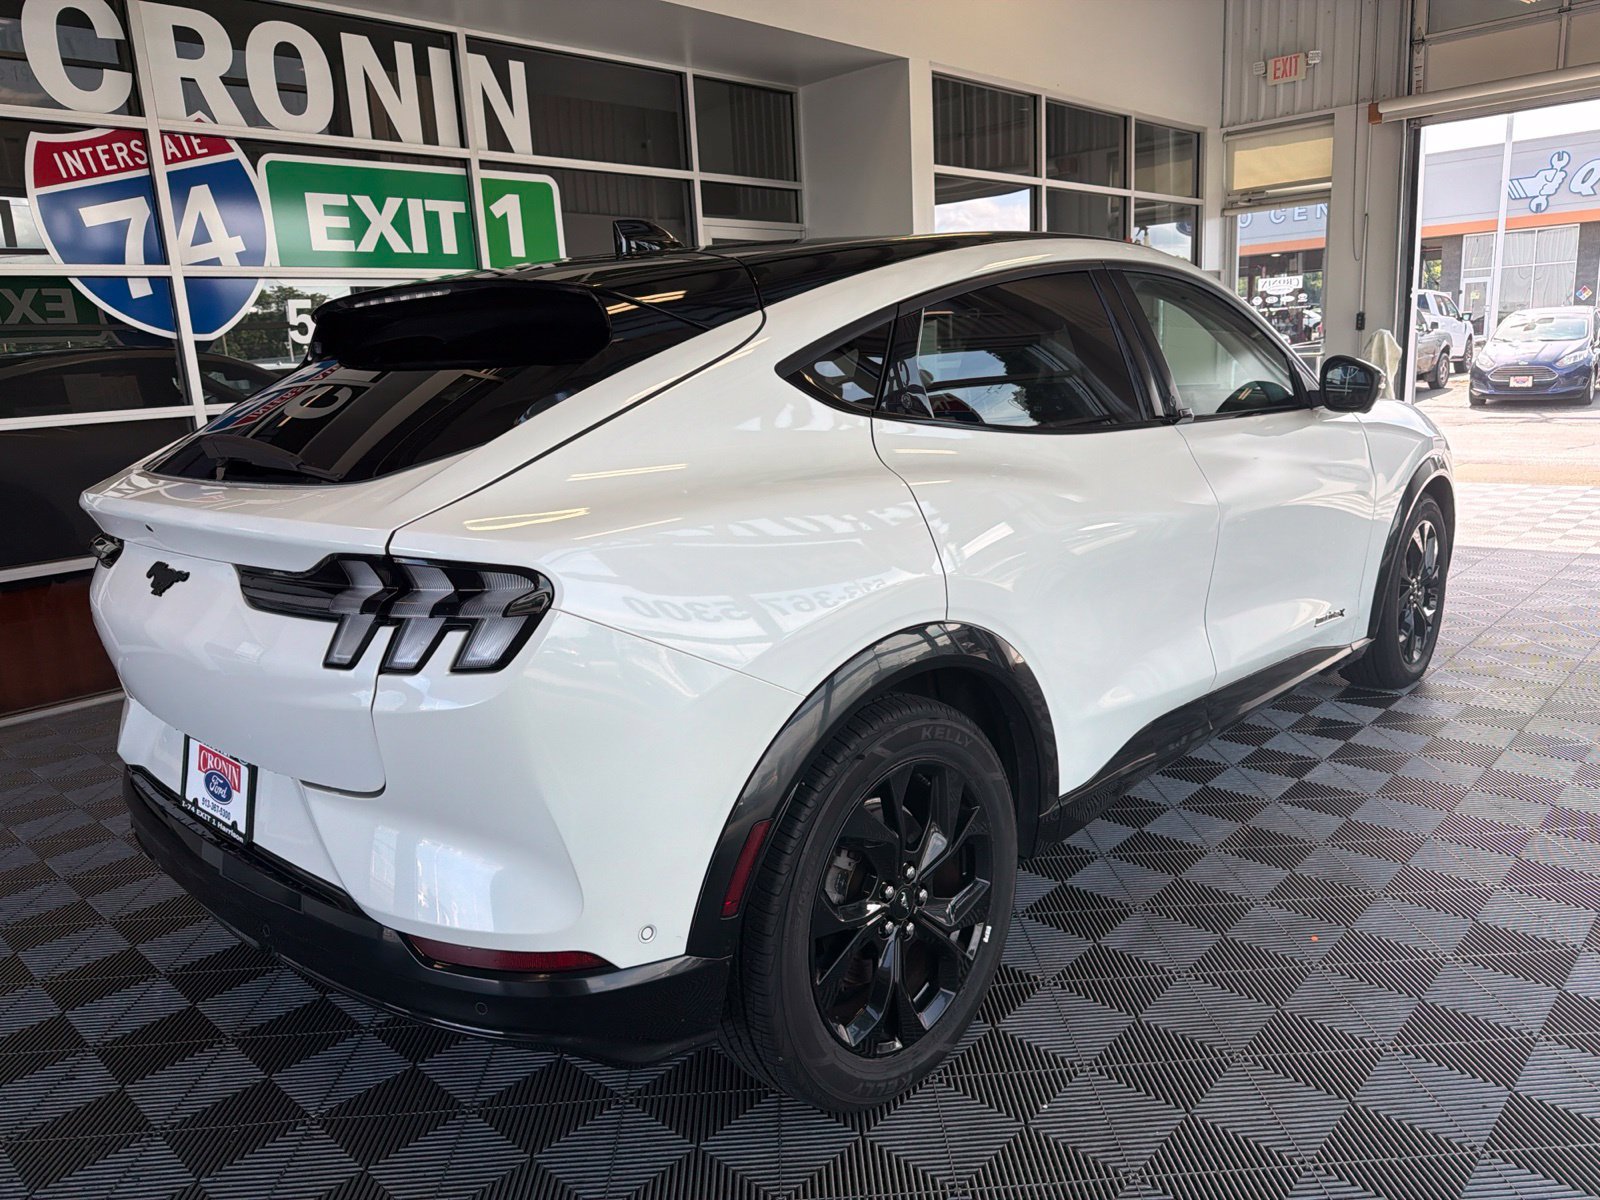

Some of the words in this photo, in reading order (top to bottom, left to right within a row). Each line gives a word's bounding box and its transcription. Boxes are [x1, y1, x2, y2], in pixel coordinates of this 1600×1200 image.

[21, 0, 534, 155] CRONIN
[1273, 55, 1300, 80] EXIT
[53, 133, 209, 179] INTERSATE
[79, 183, 246, 300] 74
[304, 191, 467, 256] EXIT
[489, 193, 526, 259] 1
[921, 725, 974, 748] KELLY
[200, 749, 240, 791] CRONIN
[209, 774, 227, 799] Ford
[196, 808, 212, 822] EXIT
[217, 820, 244, 843] Harrison
